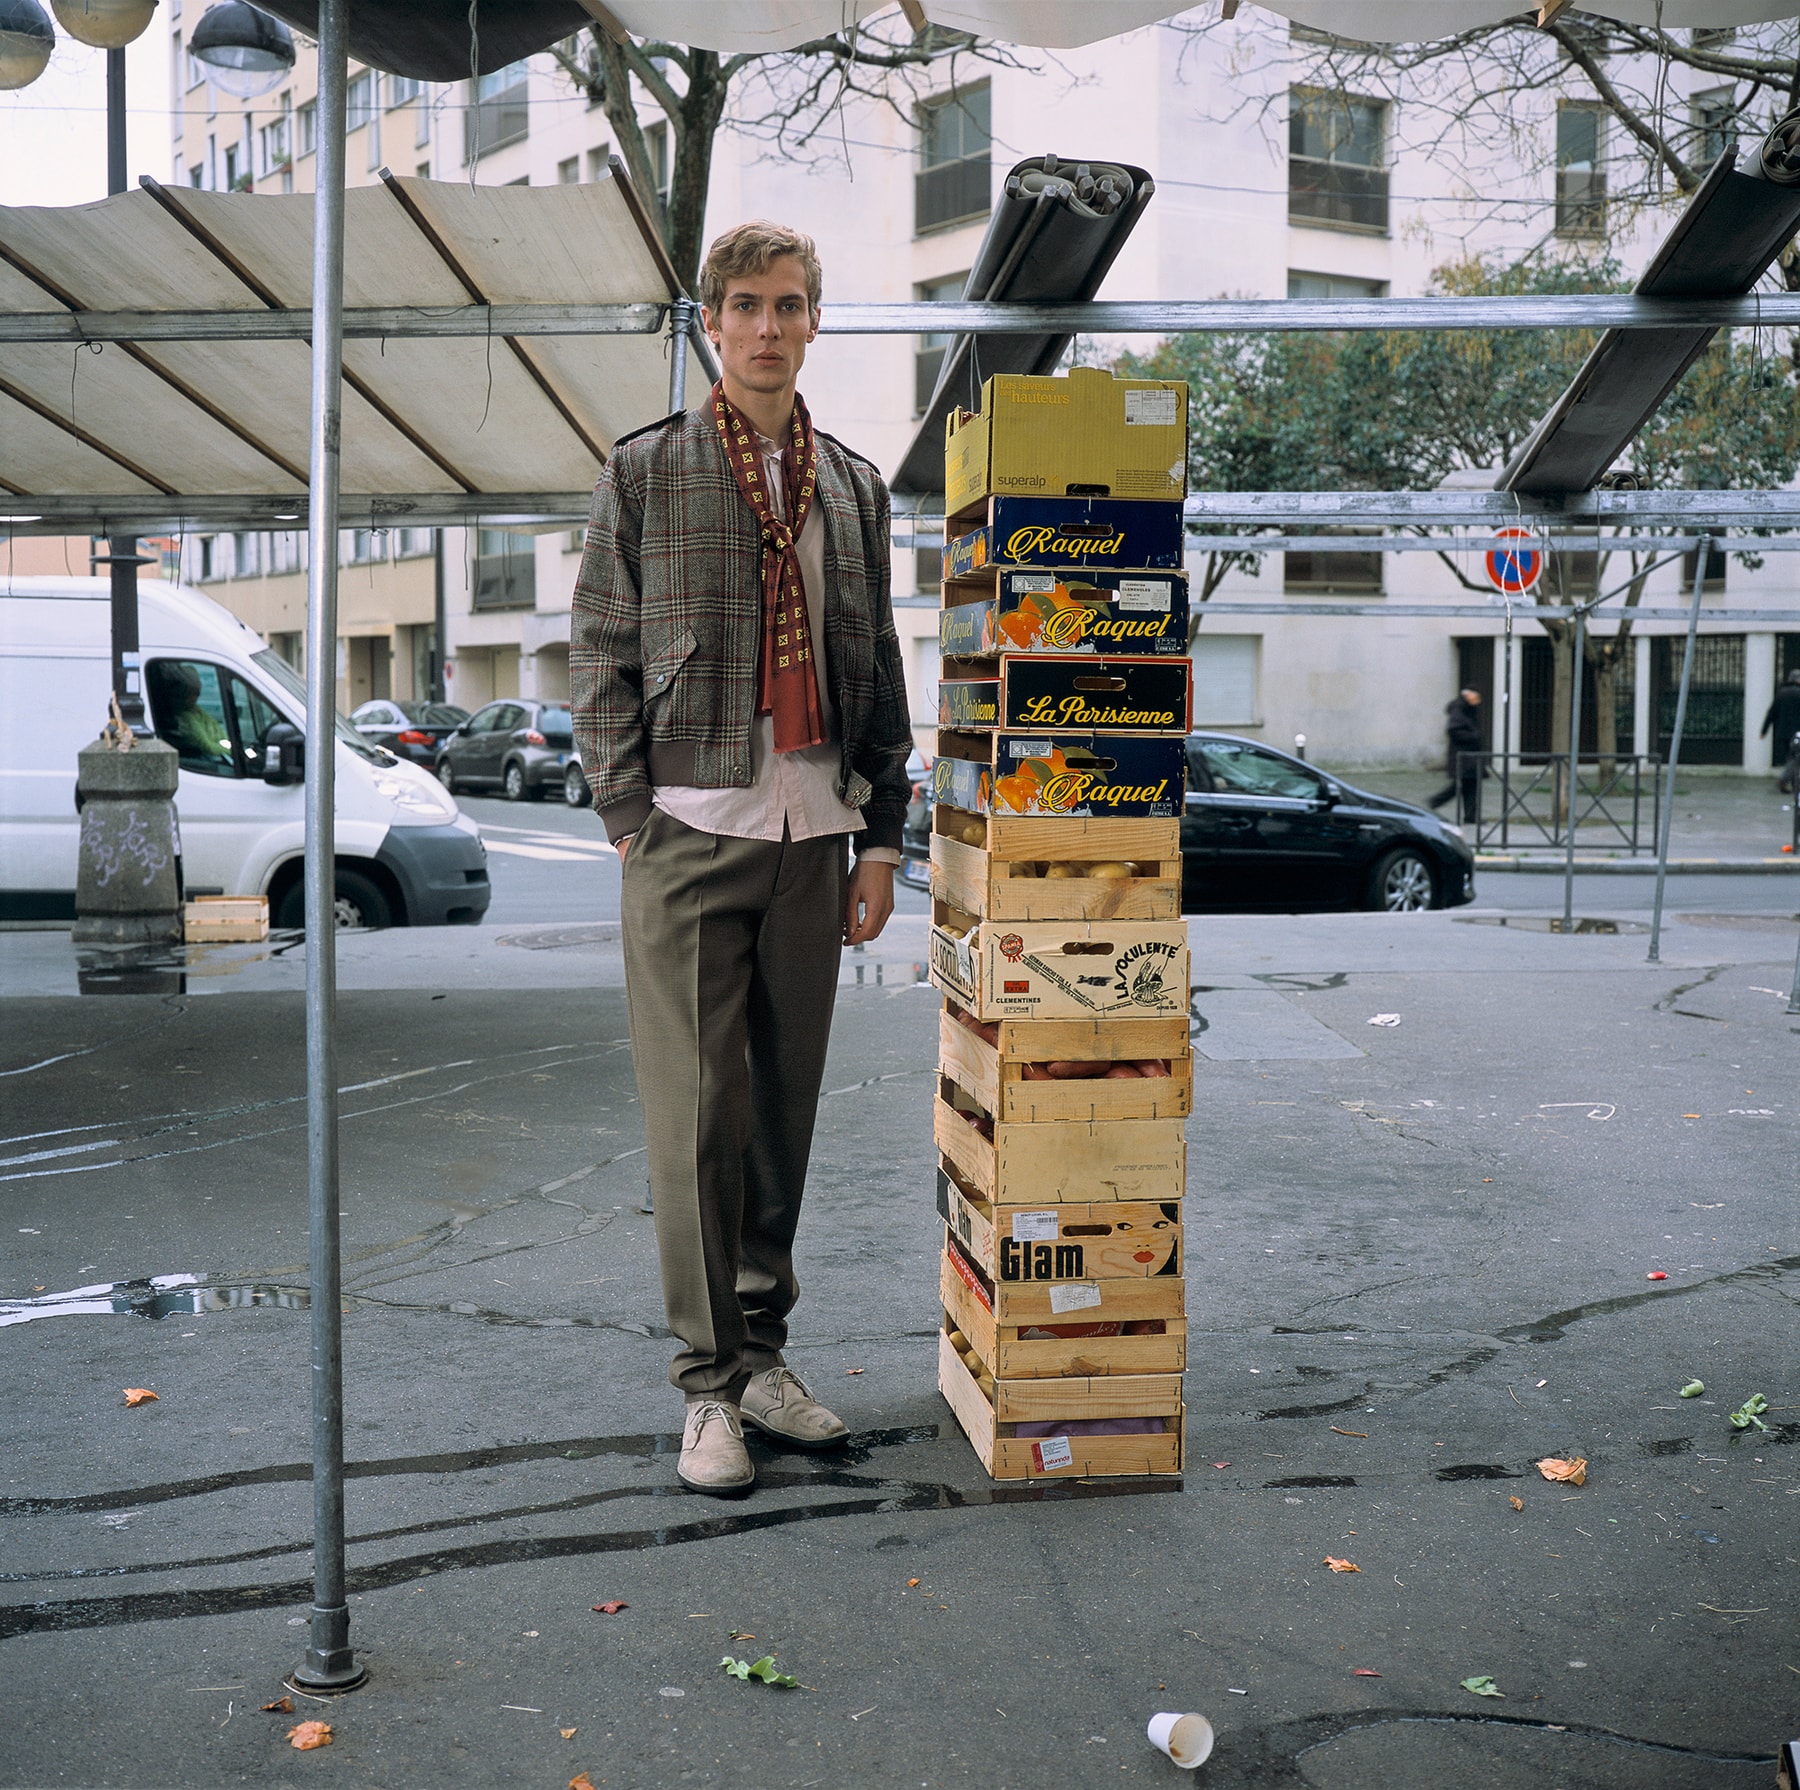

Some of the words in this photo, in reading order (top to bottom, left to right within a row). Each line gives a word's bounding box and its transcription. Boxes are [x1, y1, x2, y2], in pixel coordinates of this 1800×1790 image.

[1000, 381, 1016, 390] Les
[1018, 382, 1057, 391] saveurs
[1011, 390, 1071, 405] hauteurs
[997, 475, 1046, 488] superalp
[1003, 526, 1125, 563] Raquel
[941, 612, 974, 648] Raquel
[1041, 607, 1172, 648] Raquel
[1019, 696, 1056, 722] La
[1055, 696, 1174, 726] Parisienne
[1038, 772, 1168, 813] Raquel
[1115, 942, 1179, 981] SOCULENTE
[1114, 982, 1129, 1000] LA
[1000, 1236, 1083, 1280] Glam
